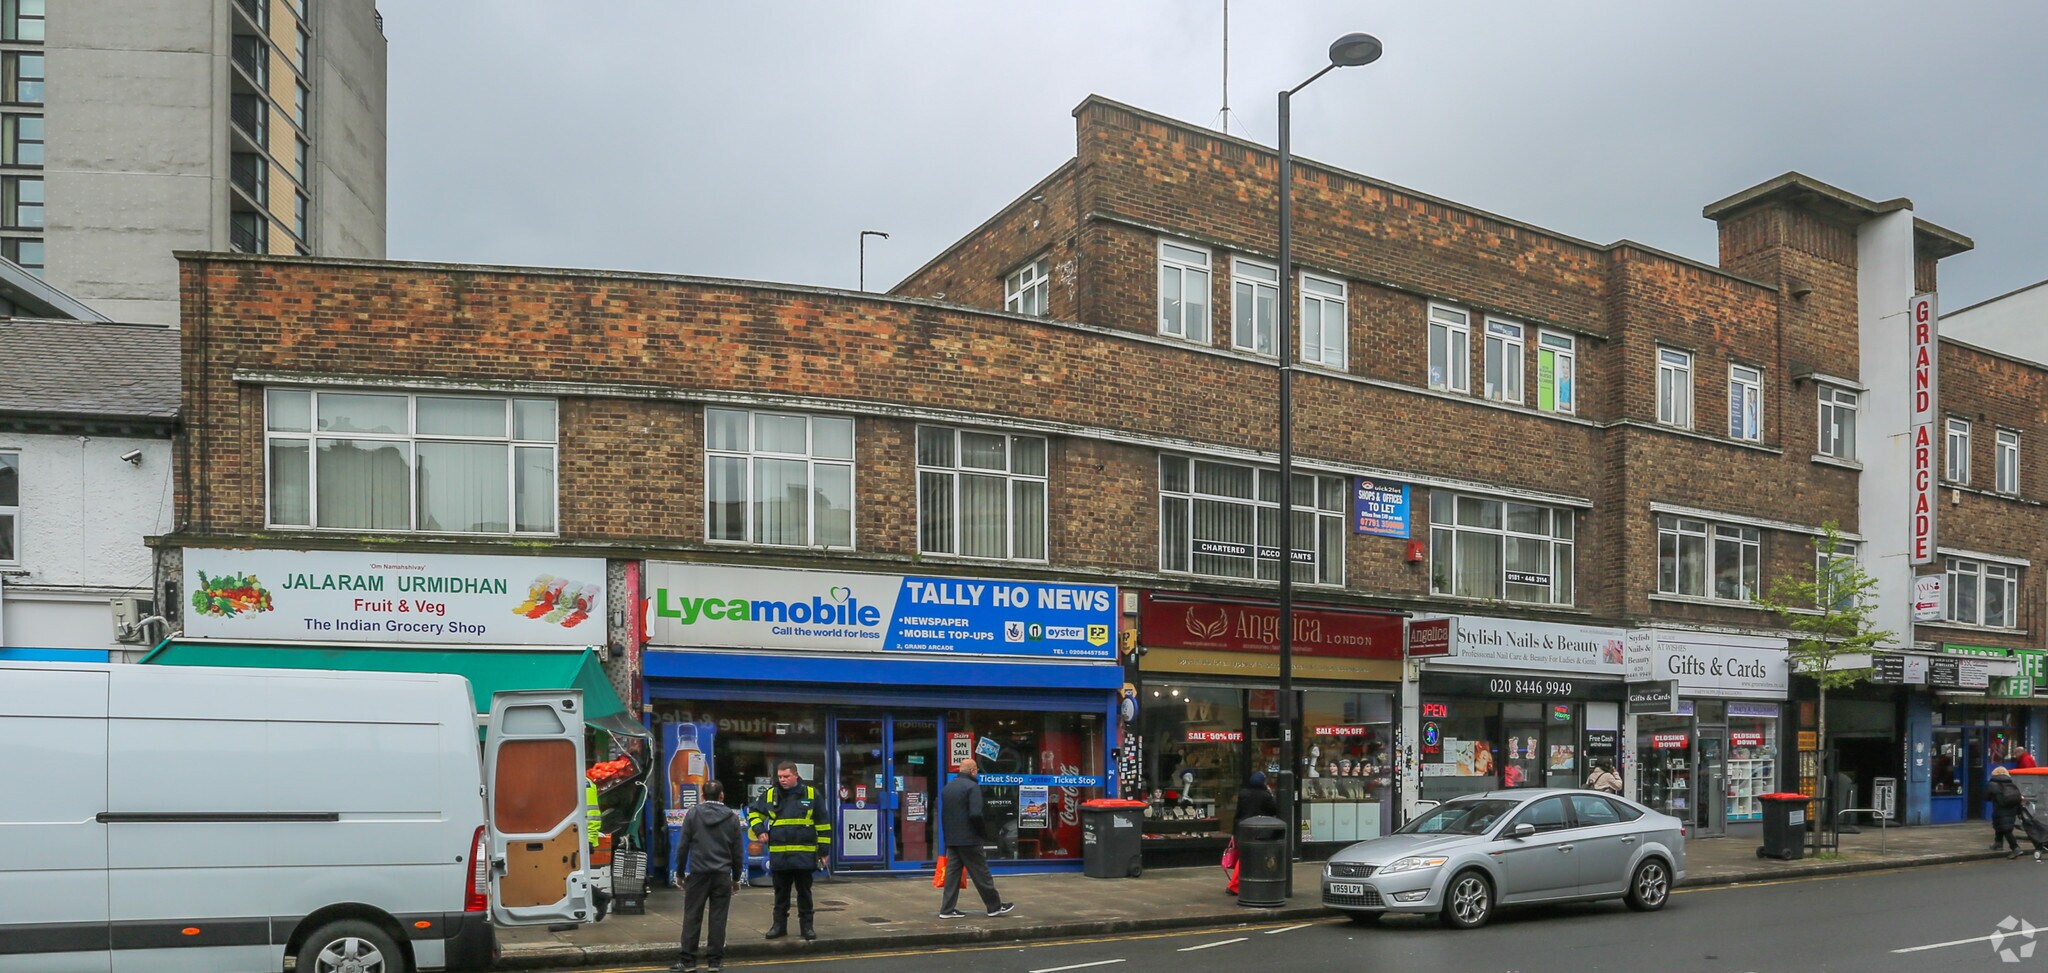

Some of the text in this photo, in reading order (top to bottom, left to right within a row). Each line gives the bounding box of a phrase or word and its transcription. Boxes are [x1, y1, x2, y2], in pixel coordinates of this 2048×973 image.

[1916, 300, 1930, 413] GRAND
[1358, 490, 1376, 502] SHOPS
[1382, 493, 1403, 505] OFFICES
[1916, 425, 1930, 559] ARCADE
[1368, 502, 1396, 514] TO LET
[1202, 543, 1312, 561] CHARTERED ACCOTANTS
[282, 574, 508, 594] JALARAM URMIDHAN
[906, 581, 1110, 612] TALLY HO NEWS
[354, 599, 446, 616] Fruit & Veg
[657, 588, 881, 626] Lycamobile
[304, 618, 486, 636] The Indian Grocery Shop
[904, 616, 970, 627] NEWSPAPER
[1235, 610, 1322, 645] Angeica
[772, 626, 880, 639] Call the world for less
[904, 629, 946, 639] MOBILE
[948, 630, 994, 641] TOP-UPS
[1048, 628, 1080, 638] oyster
[1410, 626, 1448, 644] Angelica
[1628, 634, 1650, 643] Stylish
[1326, 634, 1372, 646] LONDON
[1457, 628, 1600, 657] Stylish Nails & Beauty
[928, 644, 954, 652] ARCADE
[1462, 650, 1597, 666] Professional Nail Care & Beauty For Ladies & Gents
[1628, 657, 1649, 665] Beauty
[1668, 654, 1766, 678] Gifts & Cards
[1490, 679, 1572, 696] 020 8446 9949
[1630, 694, 1645, 702] Gifts
[1188, 732, 1206, 740] SALE
[980, 774, 1024, 784] Ticket Stop
[1054, 776, 1096, 786] Ticket Stop
[848, 823, 872, 832] PLAY
[848, 832, 872, 840] NOW
[1332, 884, 1362, 894] YR59 LPX
